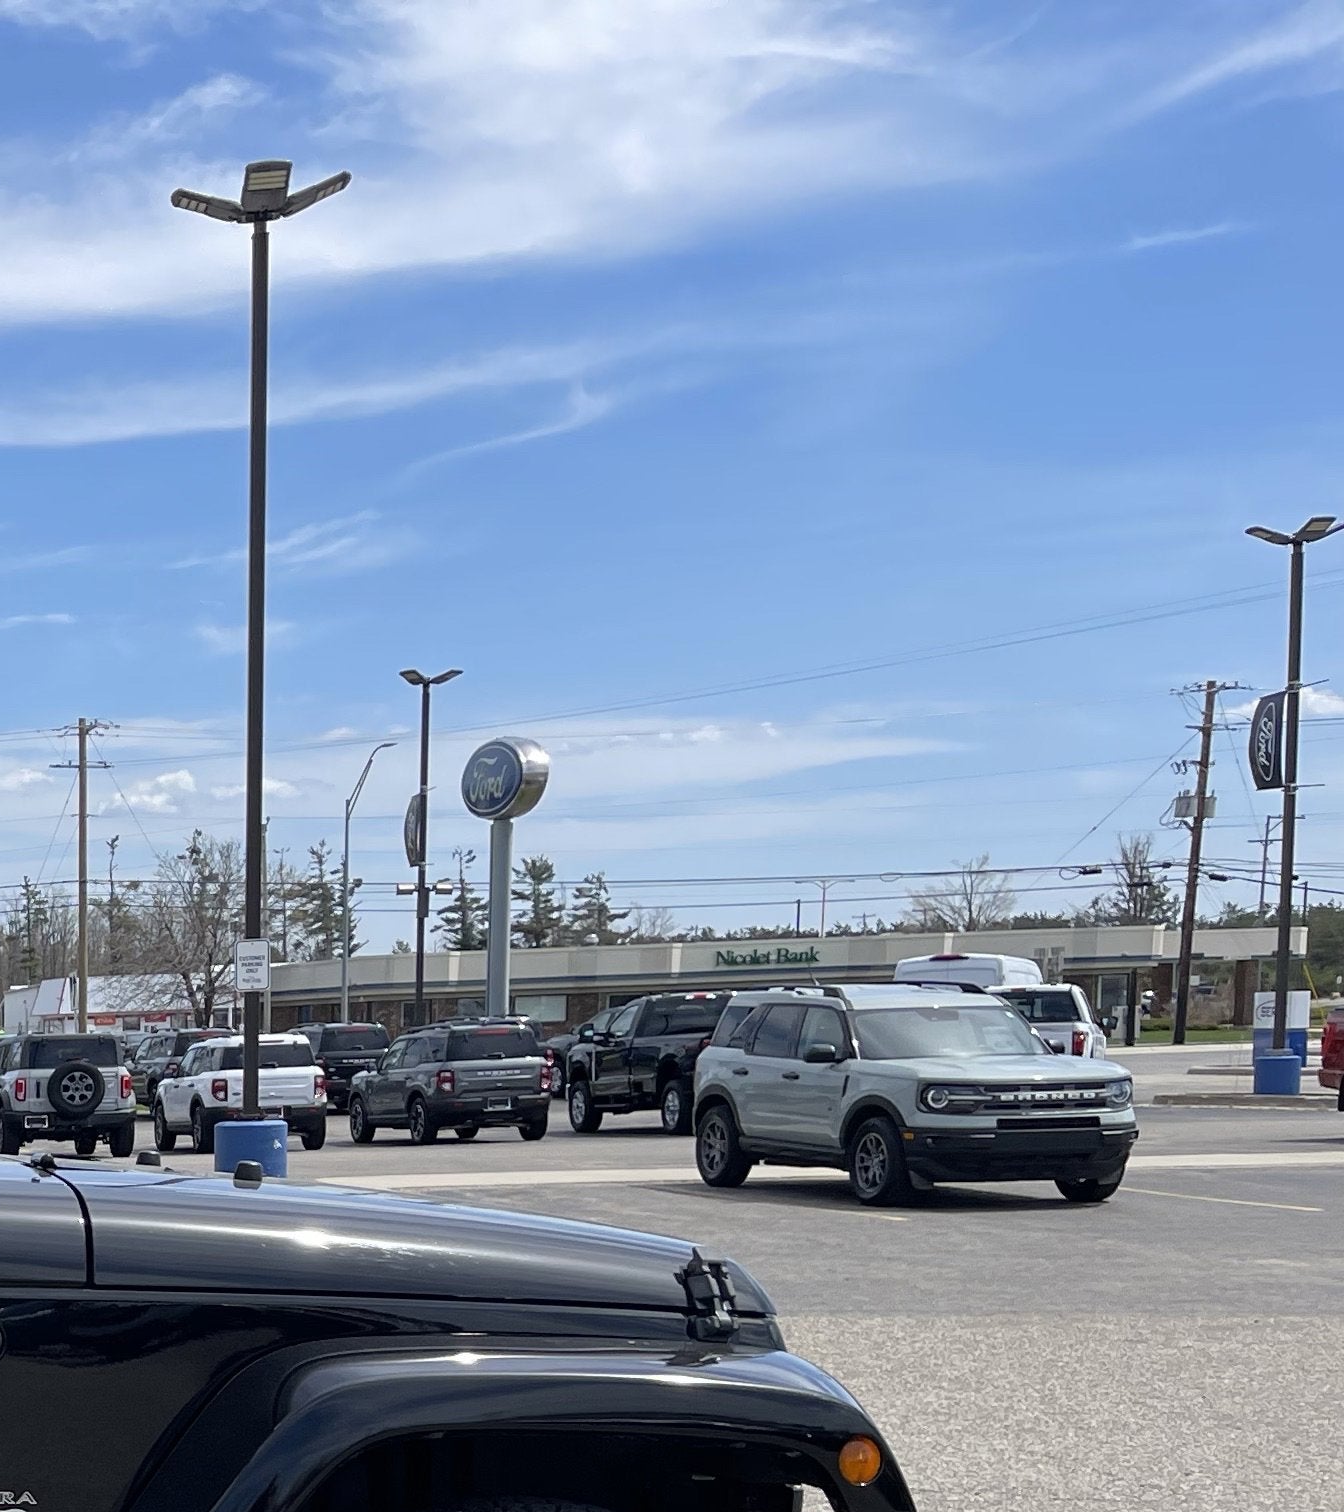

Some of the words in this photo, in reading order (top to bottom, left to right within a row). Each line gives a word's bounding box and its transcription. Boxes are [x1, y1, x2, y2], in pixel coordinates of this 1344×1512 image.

[469, 757, 508, 802] Ford
[716, 949, 772, 966] Nicolet
[776, 946, 820, 963] Bank
[1000, 1092, 1096, 1101] BRONCO
